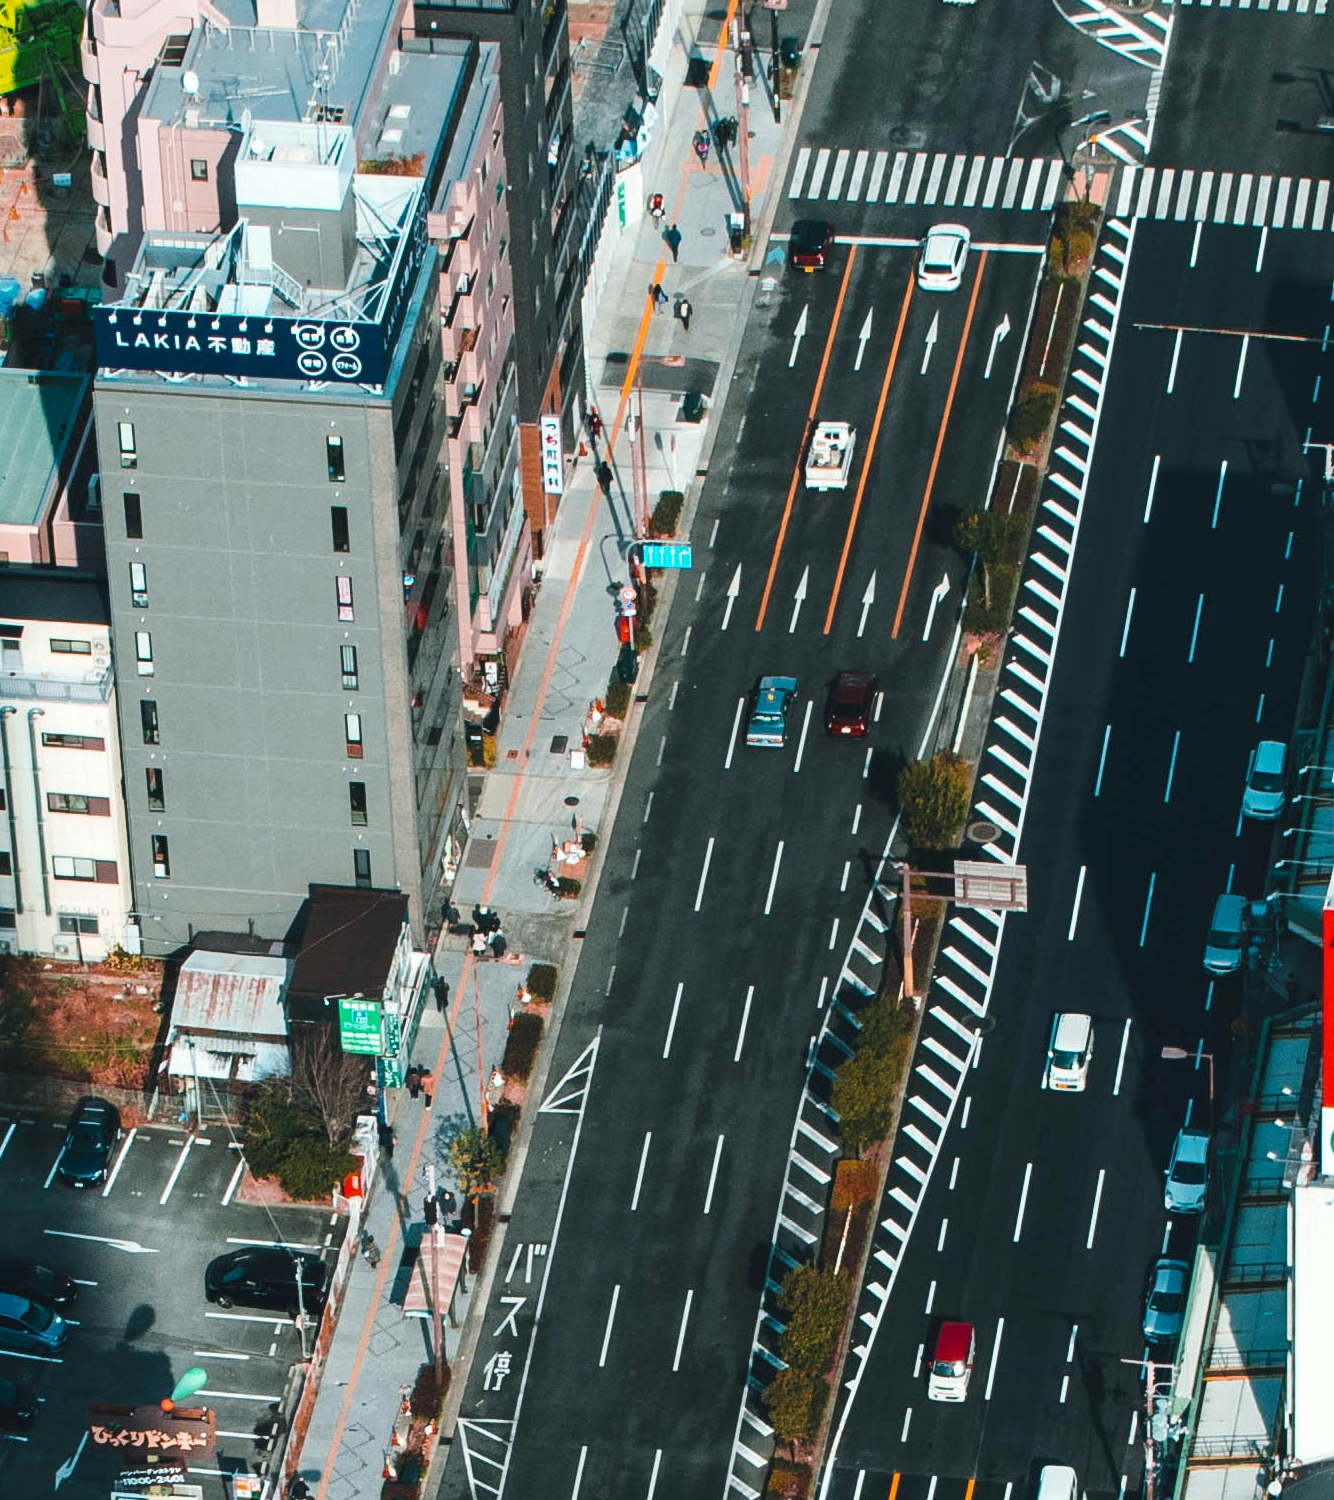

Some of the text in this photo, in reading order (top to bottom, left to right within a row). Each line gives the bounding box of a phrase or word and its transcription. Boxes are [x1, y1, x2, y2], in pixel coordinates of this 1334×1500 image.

[115, 331, 276, 356] LAKIA 不動産
[483, 1244, 547, 1391] バス停
[90, 1425, 208, 1451] びっくりドンキー
